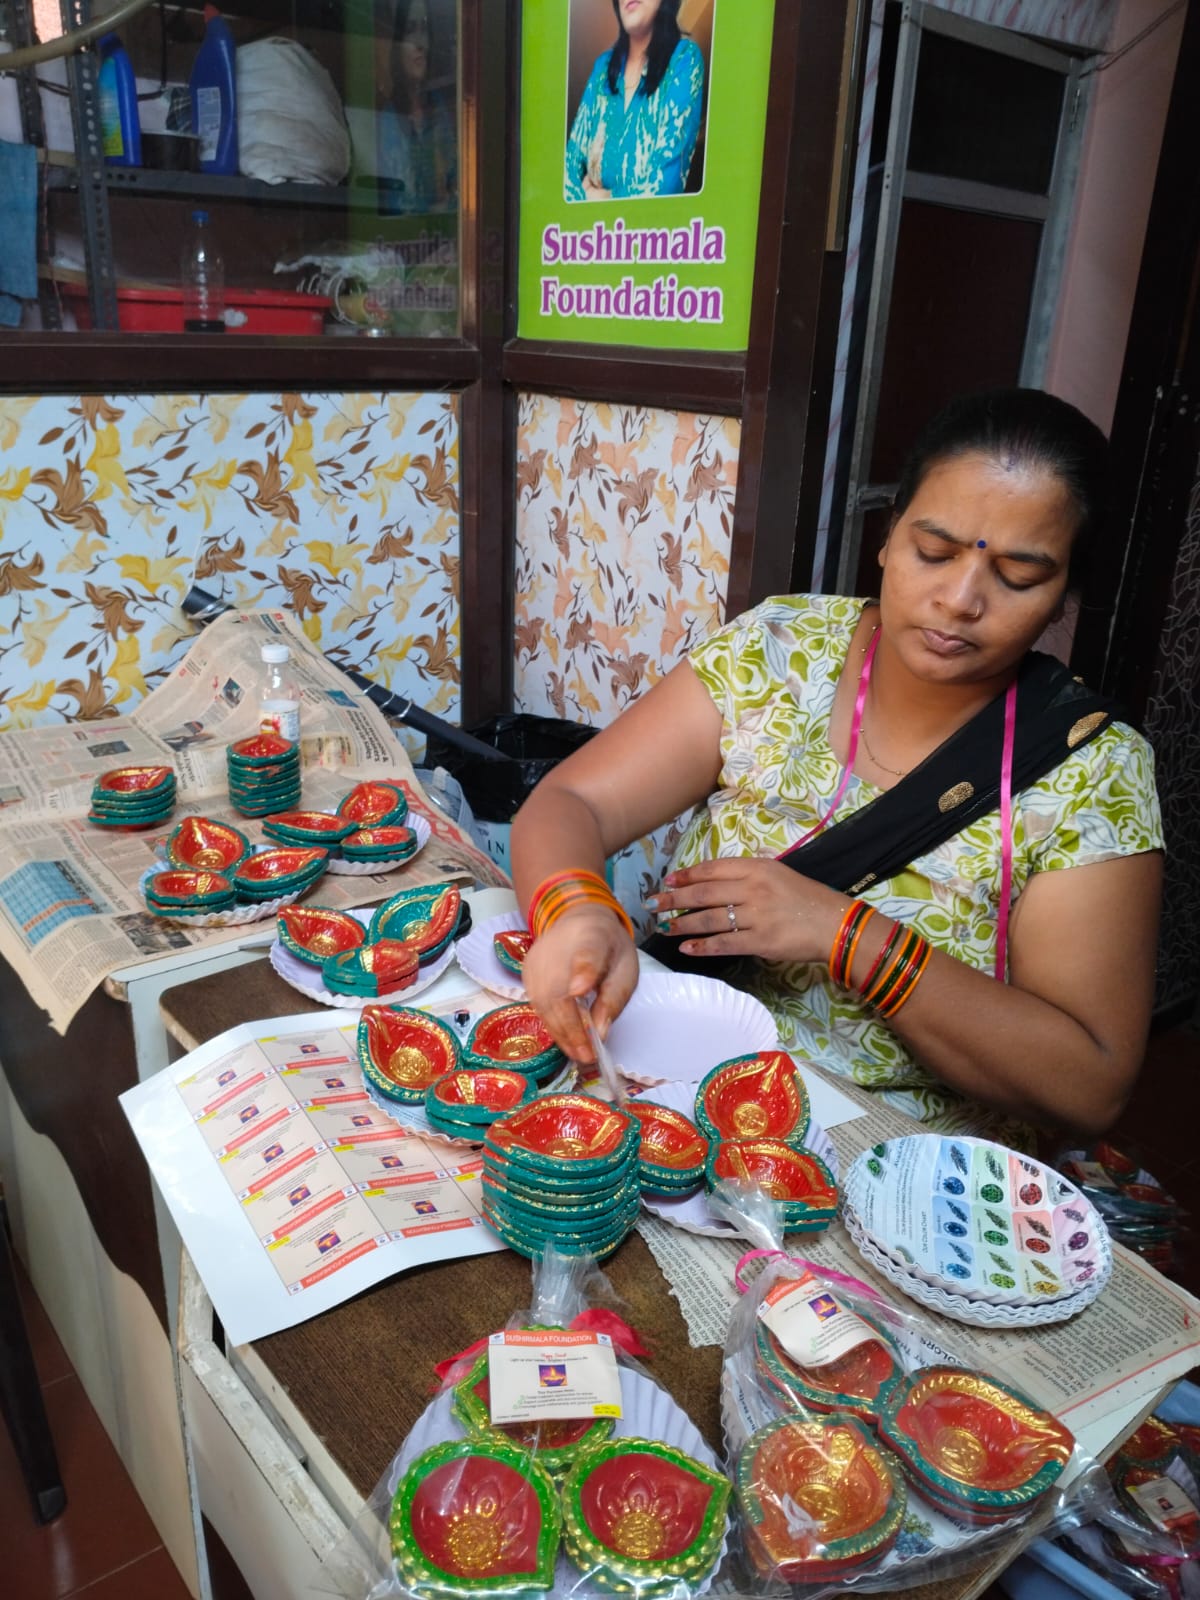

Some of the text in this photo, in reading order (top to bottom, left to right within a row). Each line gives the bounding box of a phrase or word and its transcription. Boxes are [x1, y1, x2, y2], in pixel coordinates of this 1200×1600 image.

[541, 217, 725, 264] Sushirmala
[540, 274, 723, 322] Foundation
[549, 1335, 592, 1343] FOUNDATION
